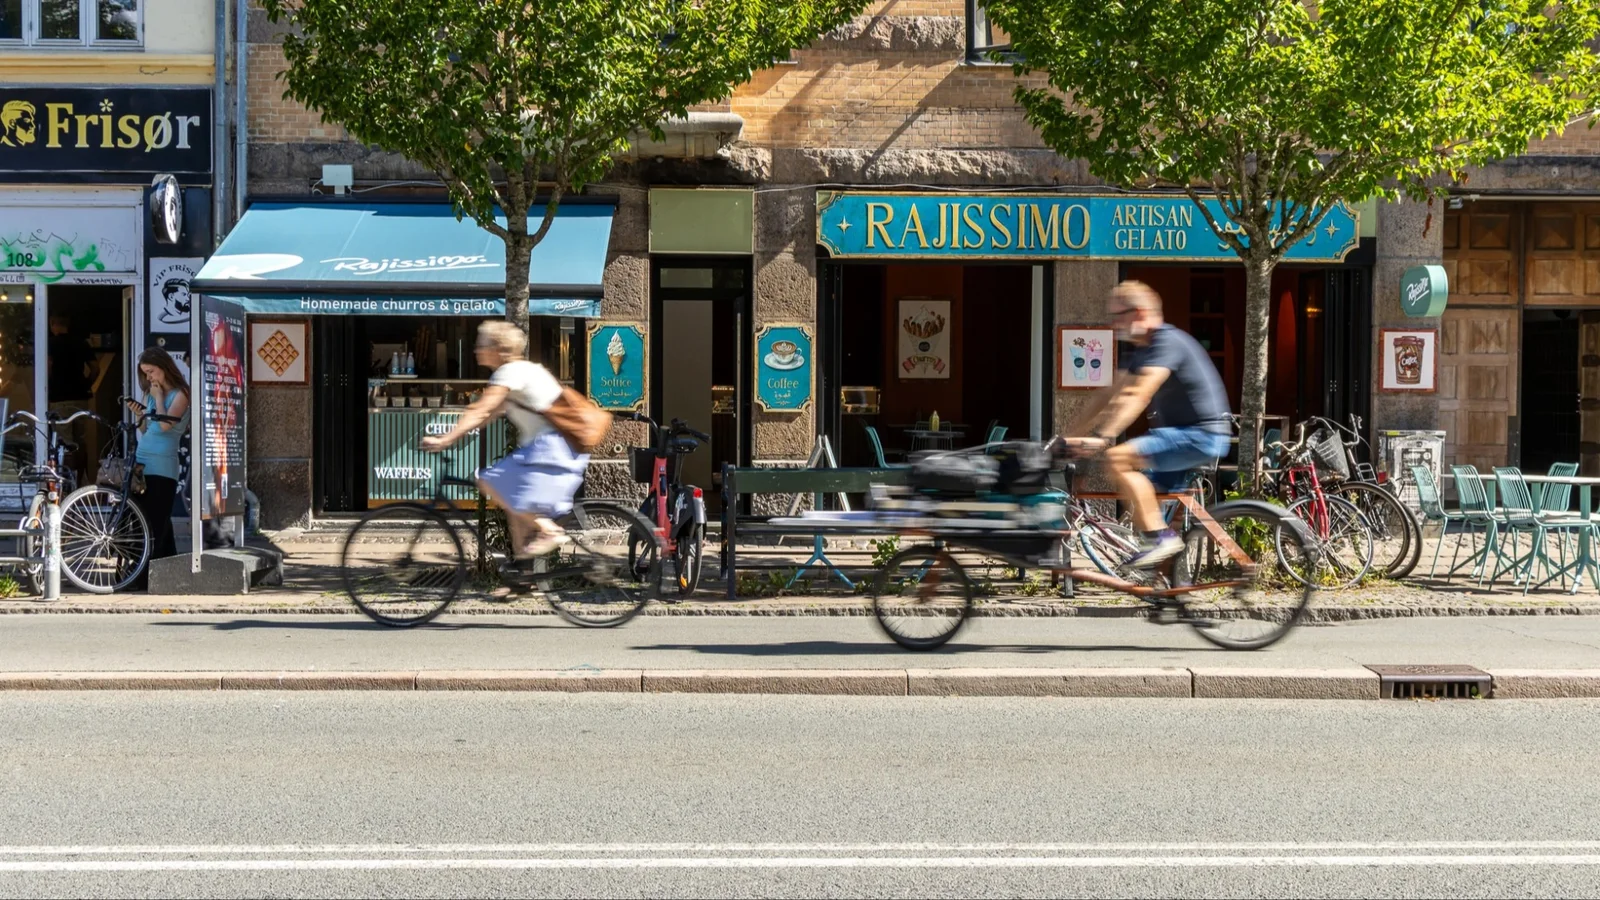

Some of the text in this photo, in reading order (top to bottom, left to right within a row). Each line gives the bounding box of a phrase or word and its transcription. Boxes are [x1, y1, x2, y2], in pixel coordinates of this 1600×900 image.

[45, 98, 200, 153] Frisør
[1111, 204, 1193, 227] ARTISAN
[865, 202, 1091, 249] RAJISSIMO
[1114, 229, 1188, 250] GELATO
[7, 252, 33, 267] 108
[300, 297, 495, 313] Homemade churros & gelato
[767, 377, 799, 389] Coffee
[374, 467, 432, 479] WAFFLES
